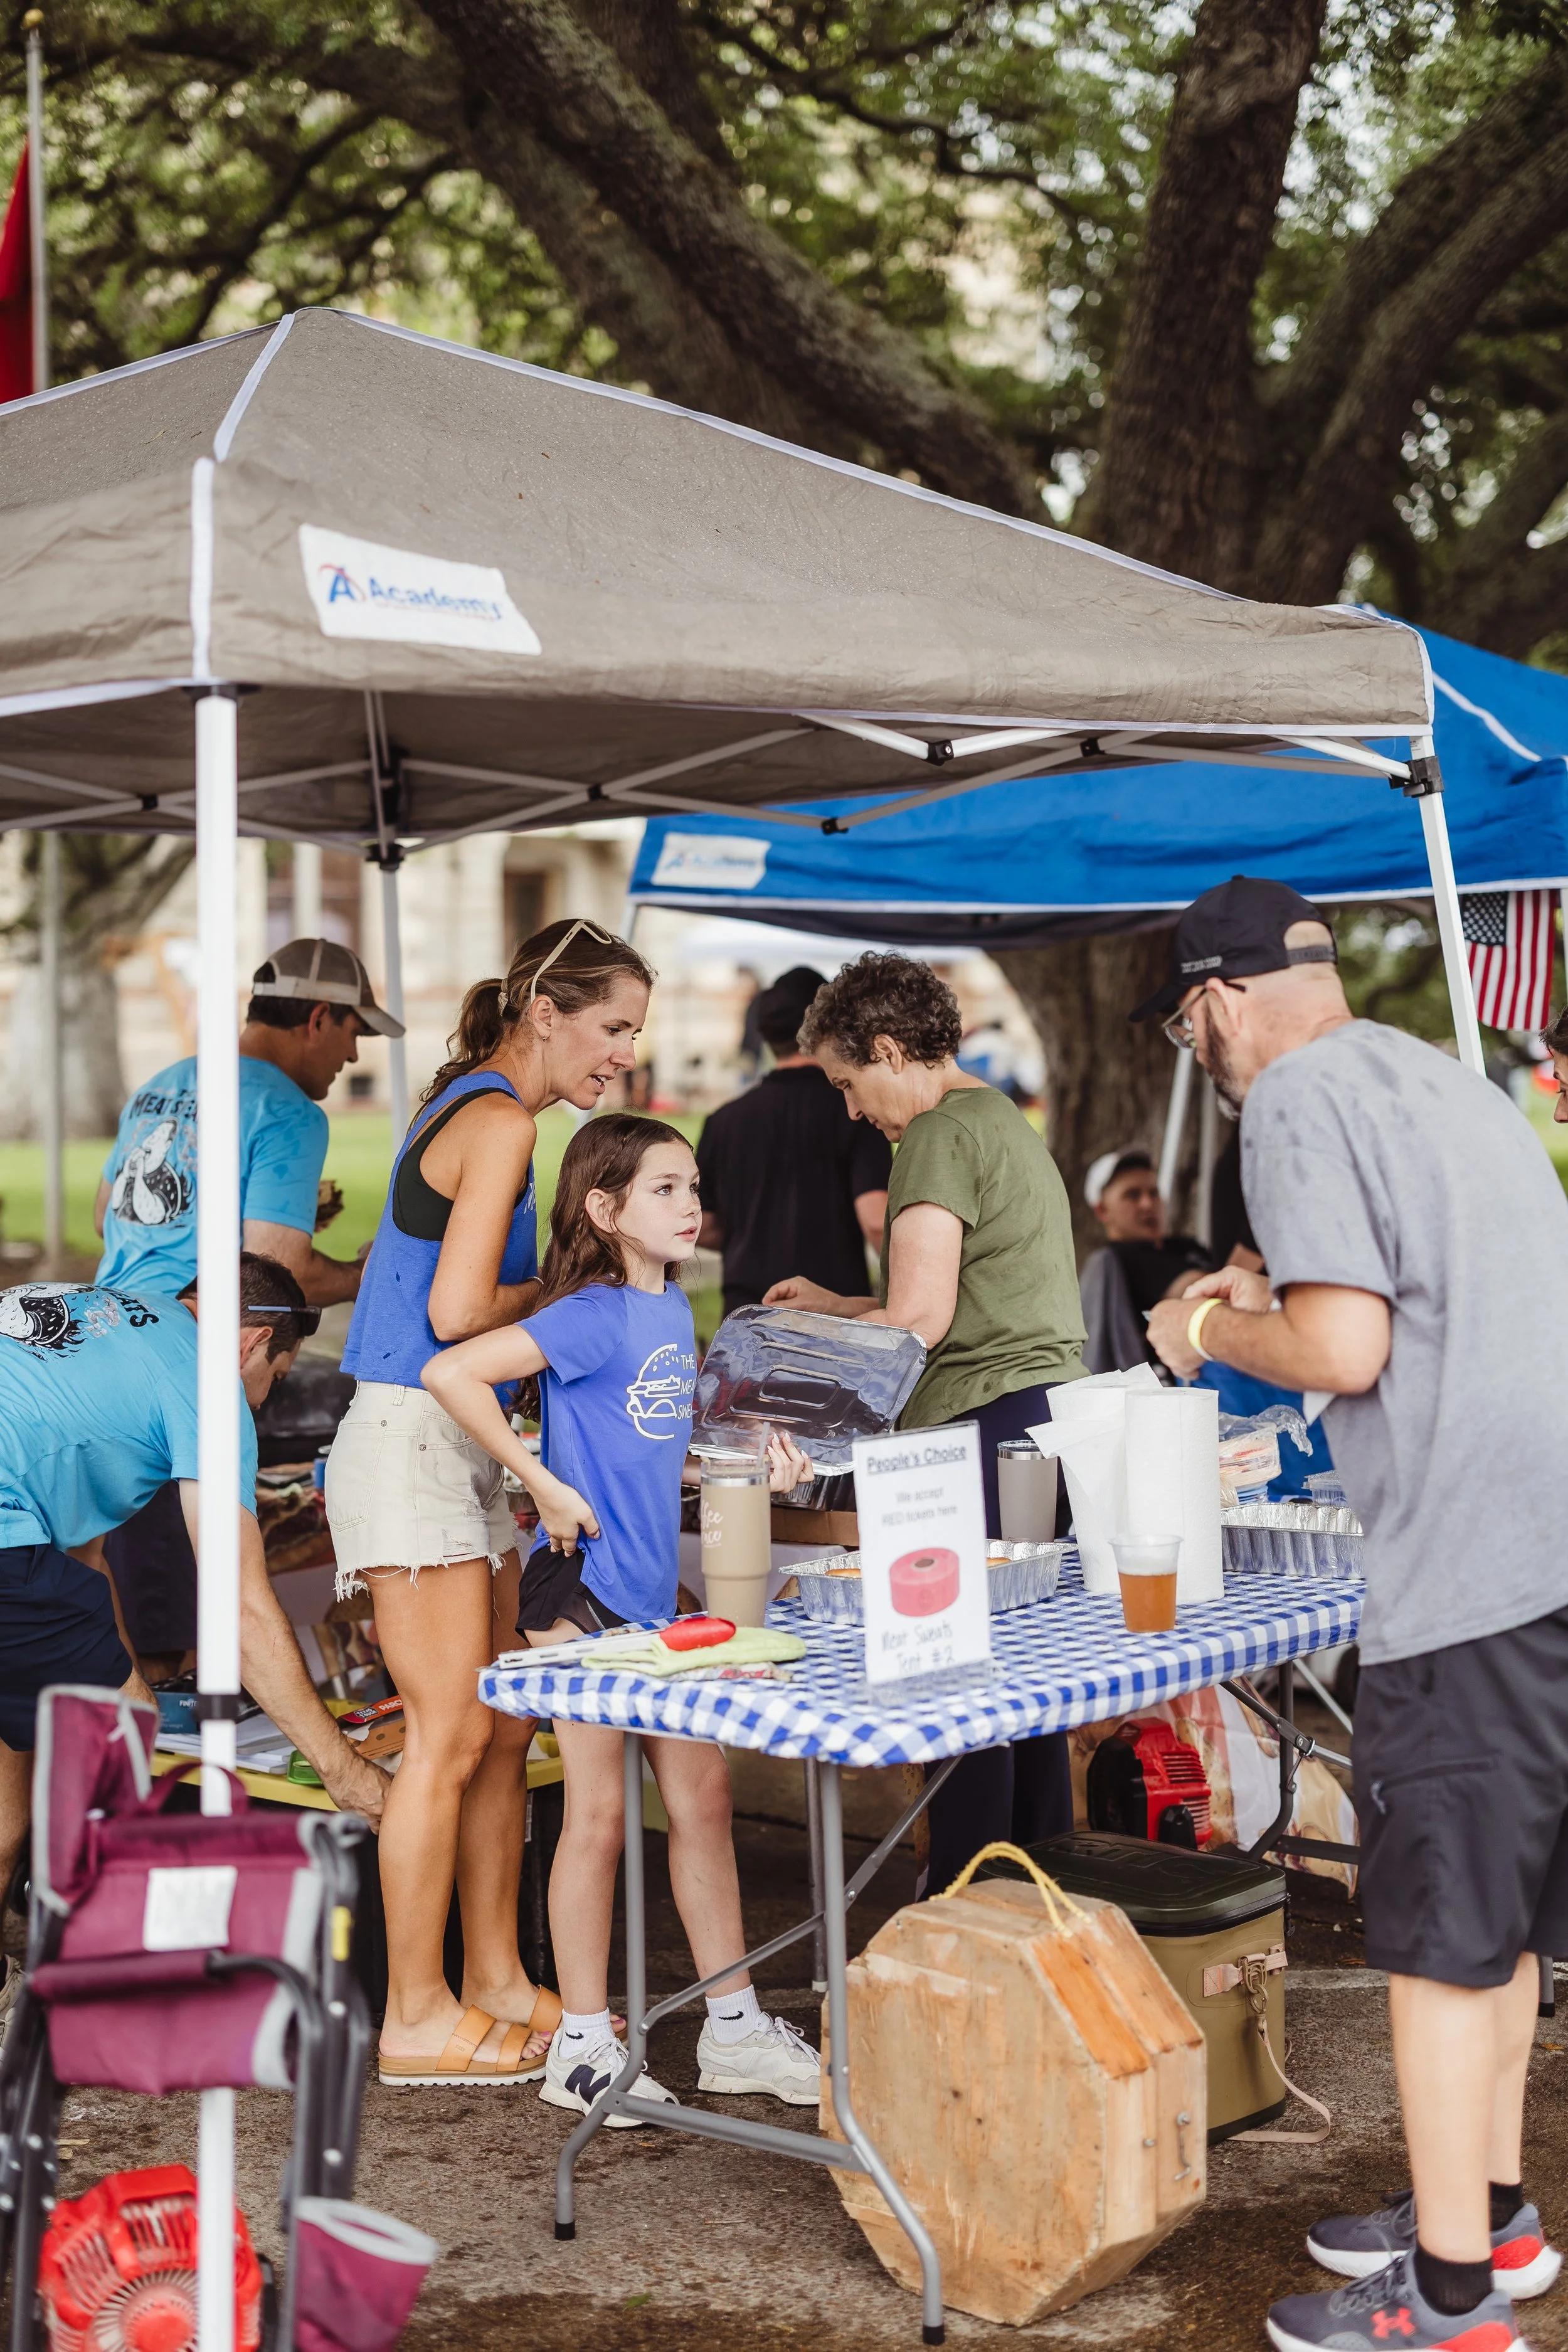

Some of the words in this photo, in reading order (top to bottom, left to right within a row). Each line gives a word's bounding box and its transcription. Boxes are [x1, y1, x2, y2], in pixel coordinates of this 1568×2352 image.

[369, 576, 502, 620] Academy
[681, 1353, 696, 1370] THE
[681, 1379, 696, 1395] MEA
[866, 1451, 920, 1472] People's
[924, 1443, 967, 1465] Choice
[378, 1699, 403, 1711] PARC
